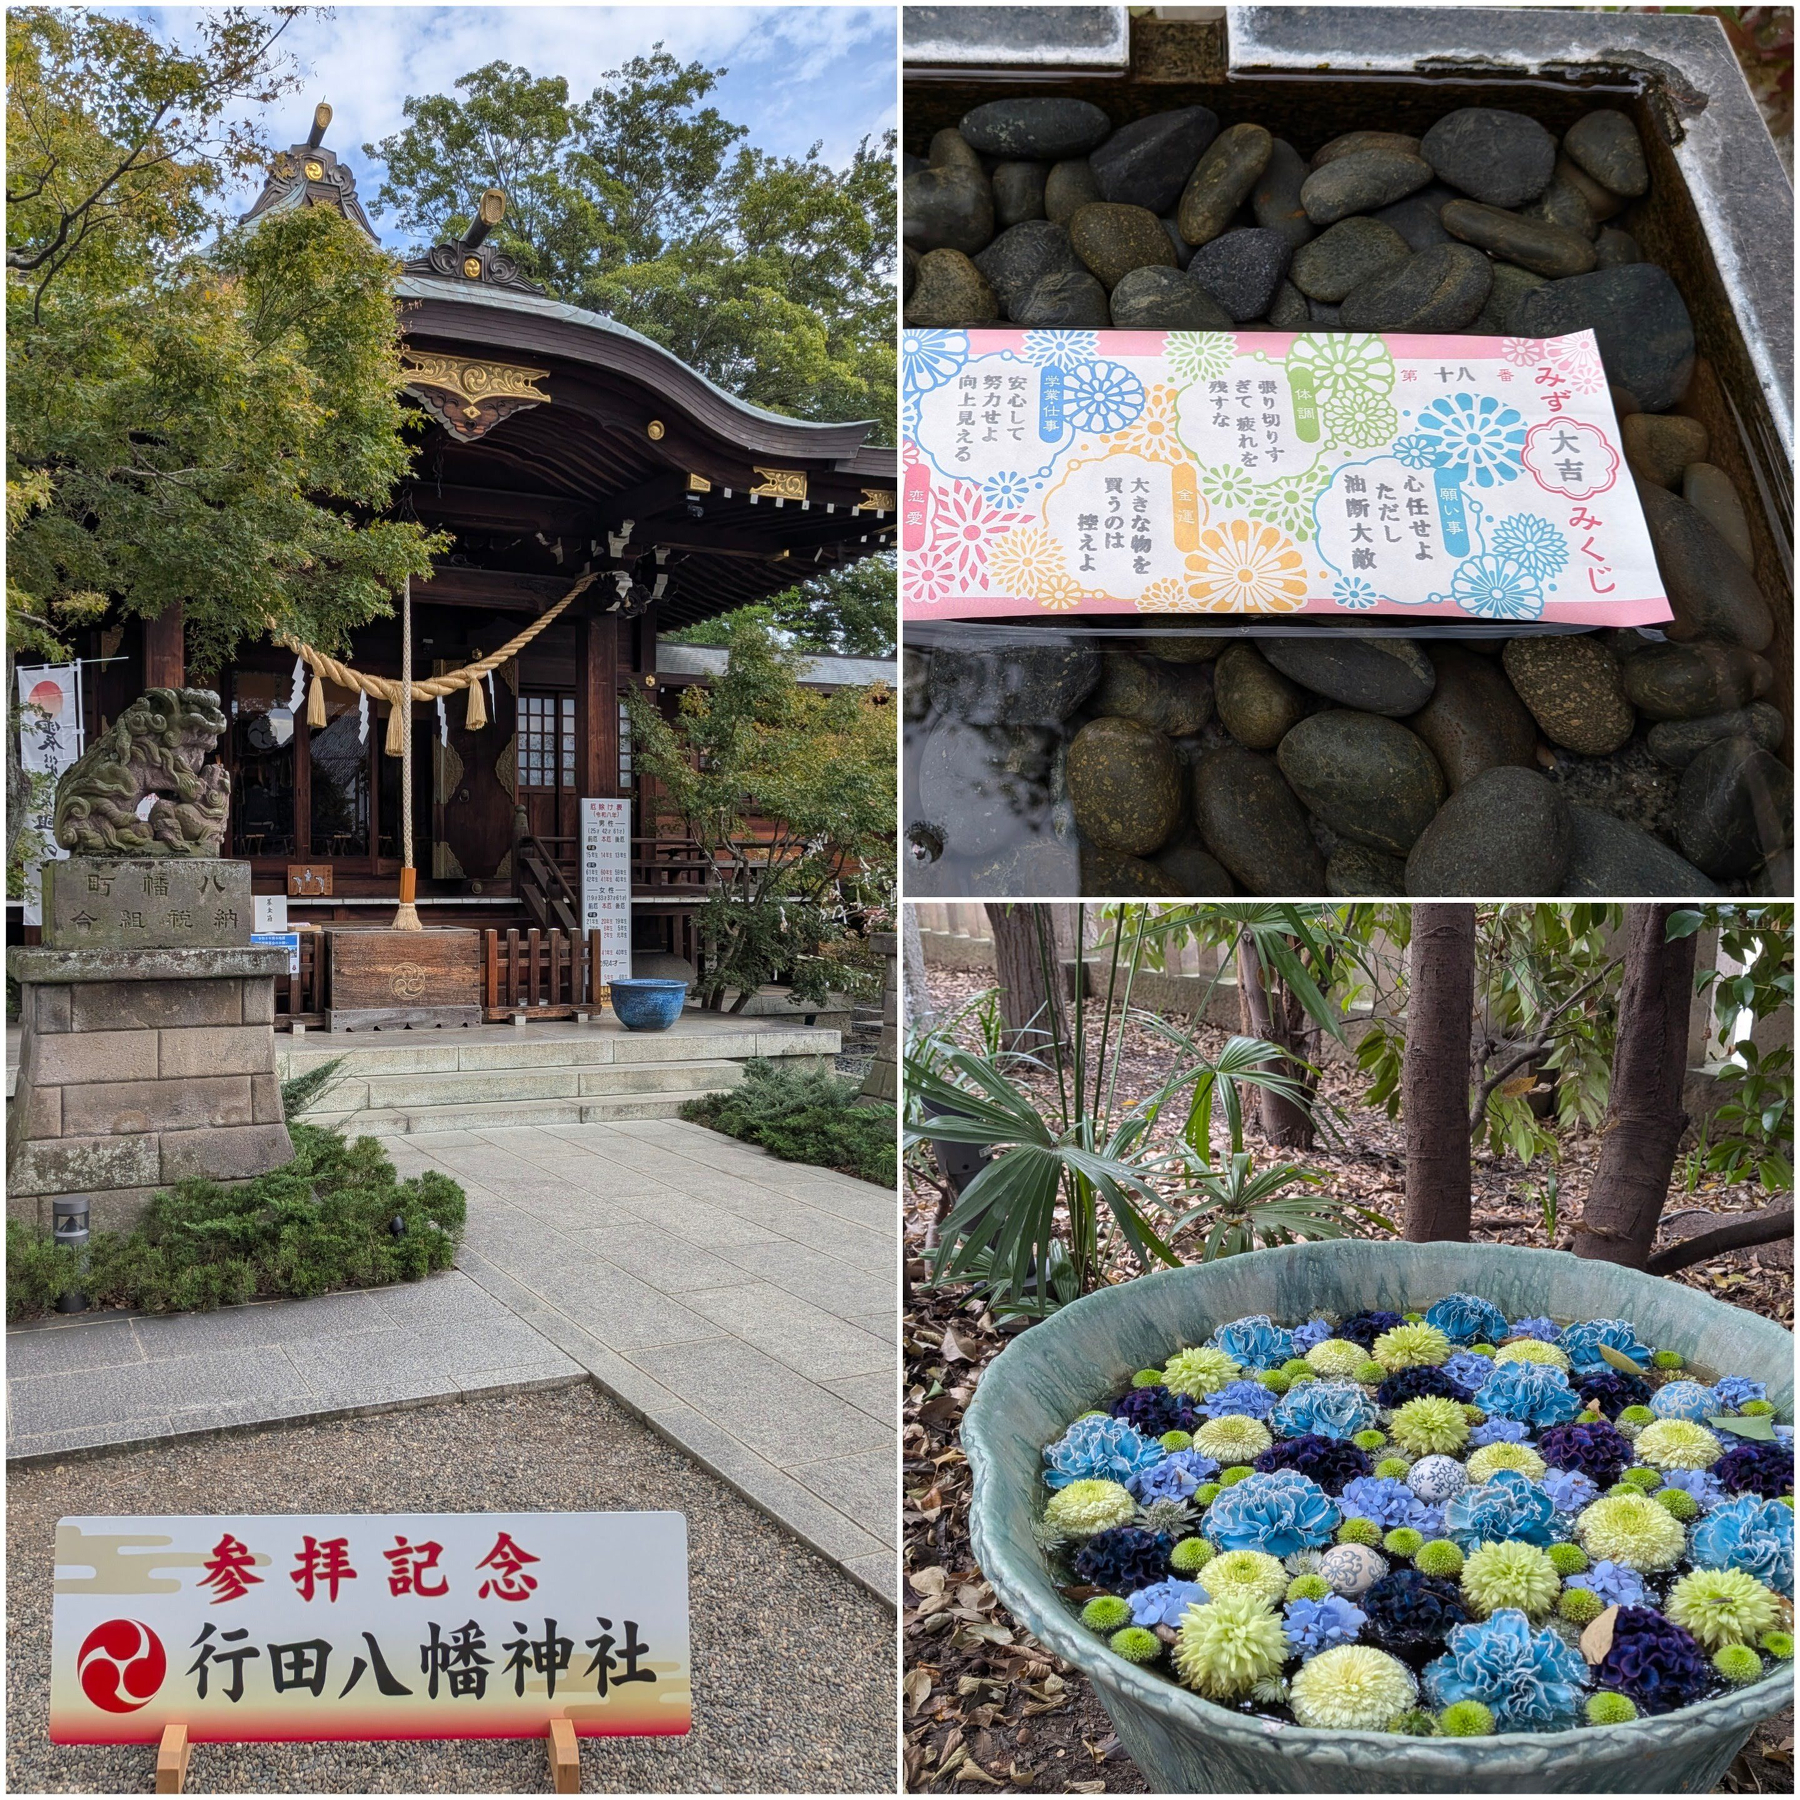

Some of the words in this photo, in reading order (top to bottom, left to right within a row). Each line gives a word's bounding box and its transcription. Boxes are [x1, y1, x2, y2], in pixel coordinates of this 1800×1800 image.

[1208, 380, 1231, 429] 残すな
[1234, 379, 1254, 409] ぎて
[1294, 388, 1315, 421] 体調
[1401, 368, 1418, 383] 第
[1432, 366, 1476, 383] 十八
[1497, 368, 1514, 383] 番
[1534, 367, 1572, 413] みず
[955, 375, 978, 462] 向上見える
[981, 375, 1002, 442] 努力せよ
[1006, 375, 1028, 441] 安心して
[1258, 380, 1286, 465] 張り切りす
[1236, 416, 1259, 468] 疲れを
[1549, 430, 1584, 483] 大吉
[906, 489, 925, 526] 恋愛
[1104, 477, 1125, 550] 買うのは
[1130, 477, 1152, 576] 大きな物を
[1176, 488, 1195, 525] 金運
[1343, 474, 1378, 571] 油断大敵
[1375, 482, 1402, 543] ただし
[1403, 475, 1434, 561] 心任せよ
[1439, 487, 1464, 536] 願い事
[1077, 513, 1099, 573] 控えよ
[1568, 506, 1617, 594] みくじ
[590, 803, 623, 811] 厄除け表
[195, 1531, 541, 1605] 参拝記念
[184, 1616, 657, 1702] 行田八幡神社
